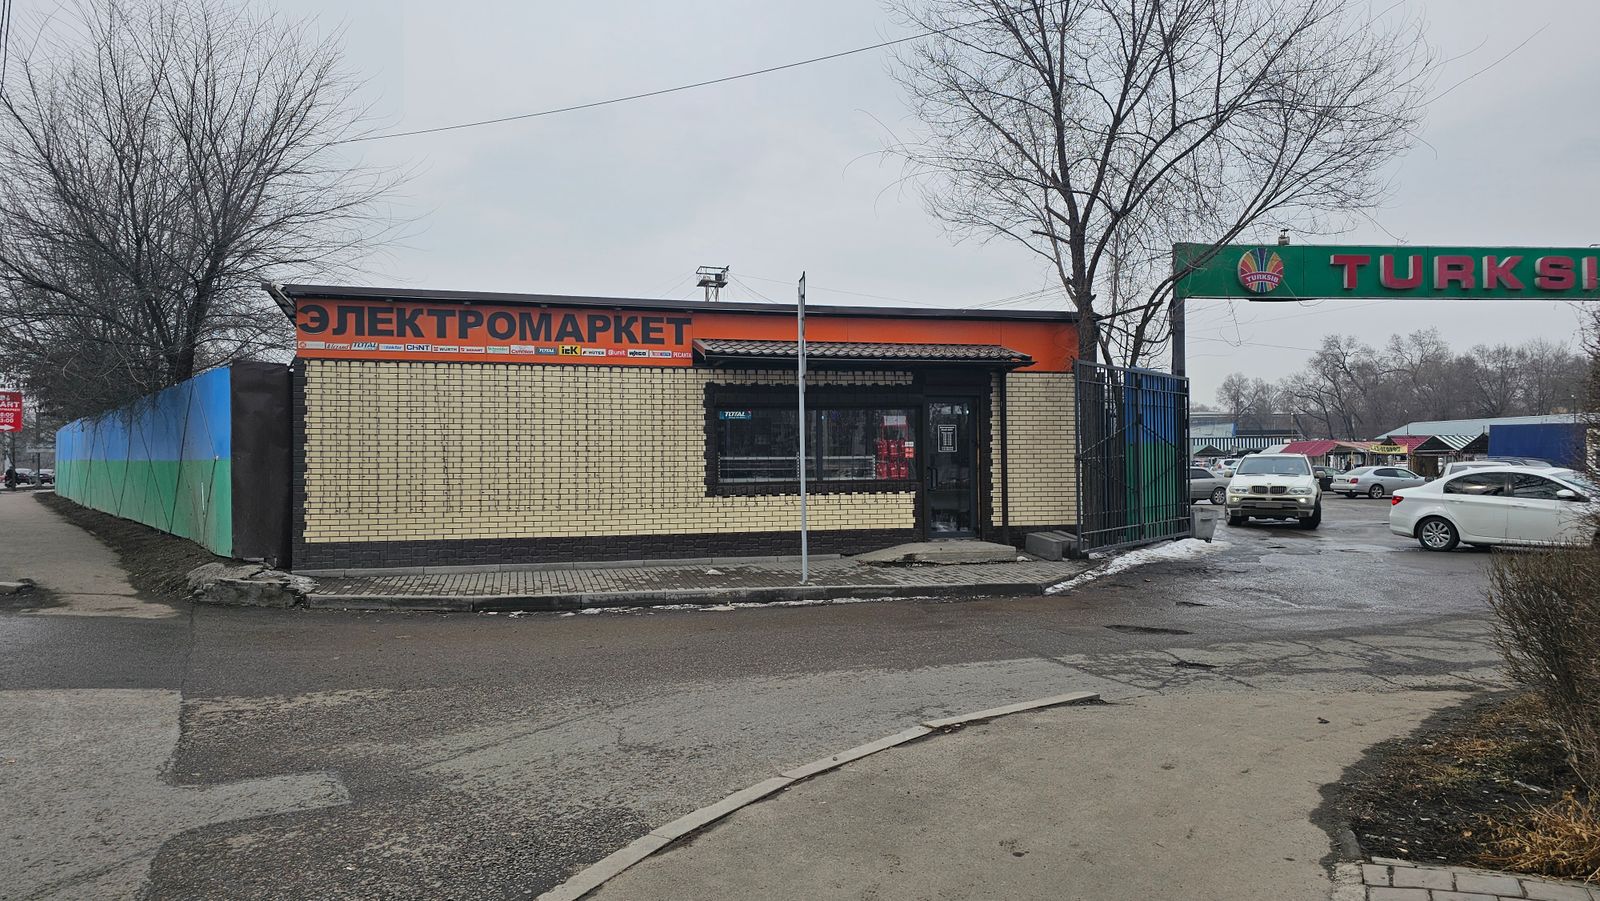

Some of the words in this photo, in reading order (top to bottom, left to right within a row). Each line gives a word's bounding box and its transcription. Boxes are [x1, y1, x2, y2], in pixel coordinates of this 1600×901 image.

[1246, 274, 1279, 282] TURKSIB
[1329, 254, 1598, 290] TURKSI
[299, 305, 692, 345] ЭЛЕКТРОМАРКЕТ
